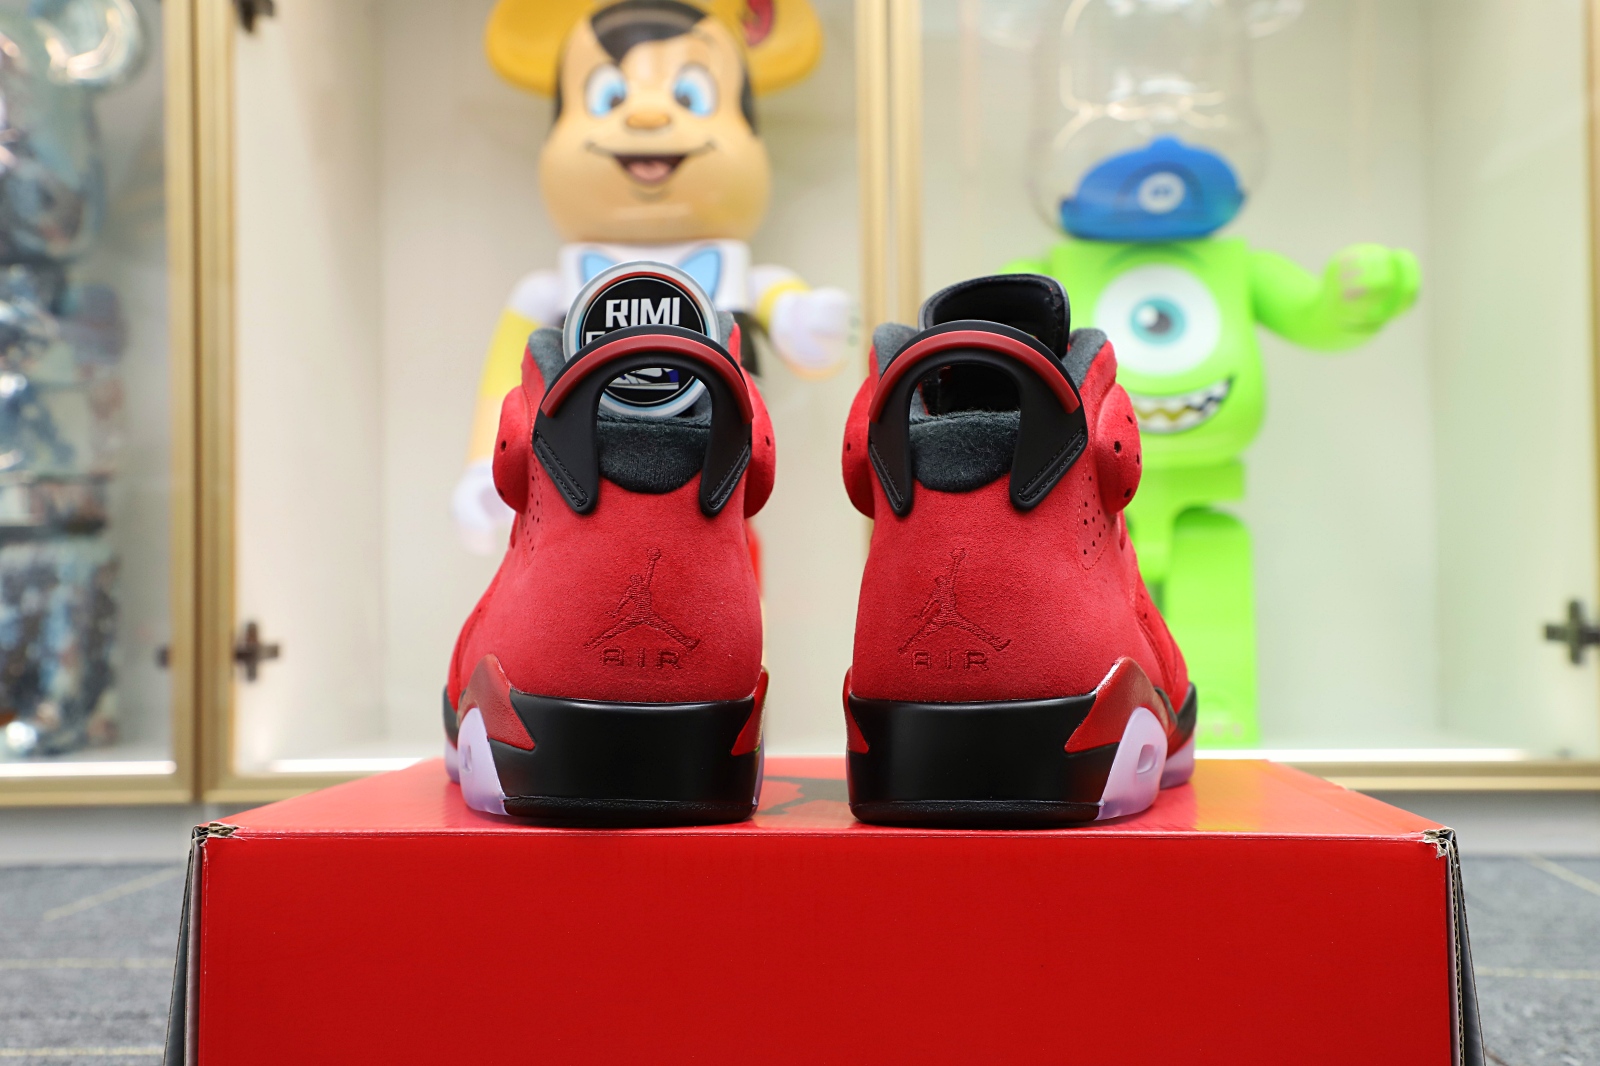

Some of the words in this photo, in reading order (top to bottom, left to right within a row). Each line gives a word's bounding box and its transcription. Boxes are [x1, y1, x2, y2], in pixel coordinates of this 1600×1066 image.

[605, 297, 681, 328] RIMI
[601, 646, 682, 669] AIR
[912, 650, 989, 671] AIR
